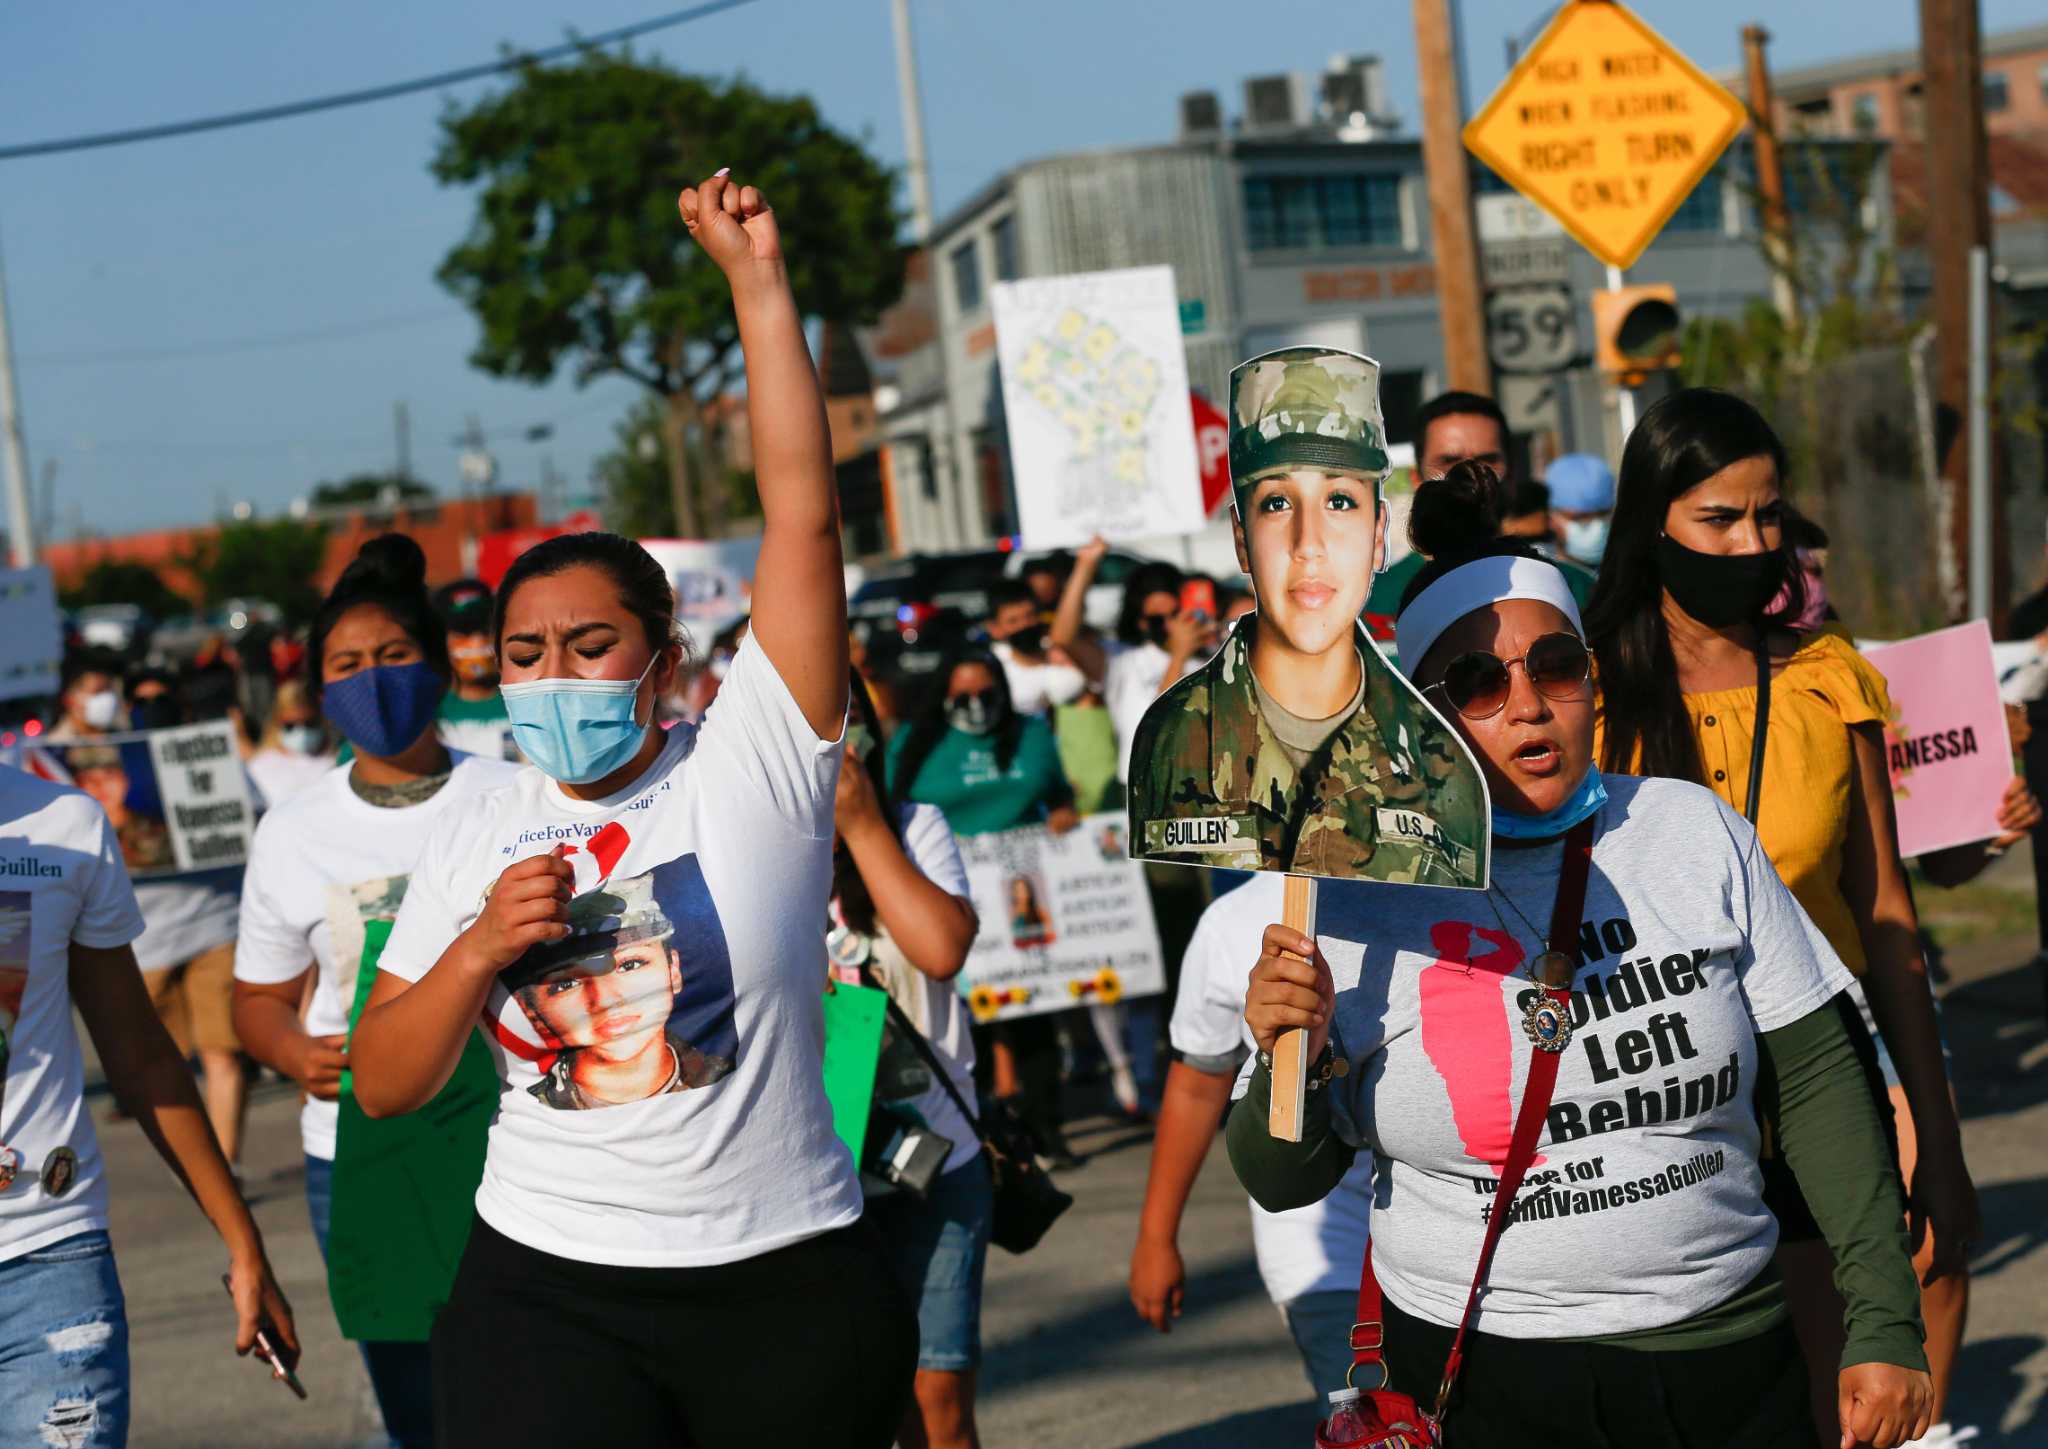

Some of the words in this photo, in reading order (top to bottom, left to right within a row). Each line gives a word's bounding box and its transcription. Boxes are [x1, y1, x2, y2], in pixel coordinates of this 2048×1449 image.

[1600, 53, 1662, 81] WATER
[1519, 101, 1572, 126] WHEN
[1589, 91, 1689, 123] FLASHING
[1521, 137, 1595, 172] RIGHT
[1624, 132, 1694, 166] TURN
[1571, 176, 1651, 212] ONLY
[1497, 305, 1565, 357] 59
[1890, 726, 1978, 771] ANESSA
[1165, 820, 1227, 845] GUILLEN
[1576, 918, 1637, 970] No
[1517, 946, 1710, 1031] oldier
[1582, 1011, 1699, 1085] Left
[1548, 1051, 1740, 1144] Behind
[1564, 1156, 1605, 1183] for
